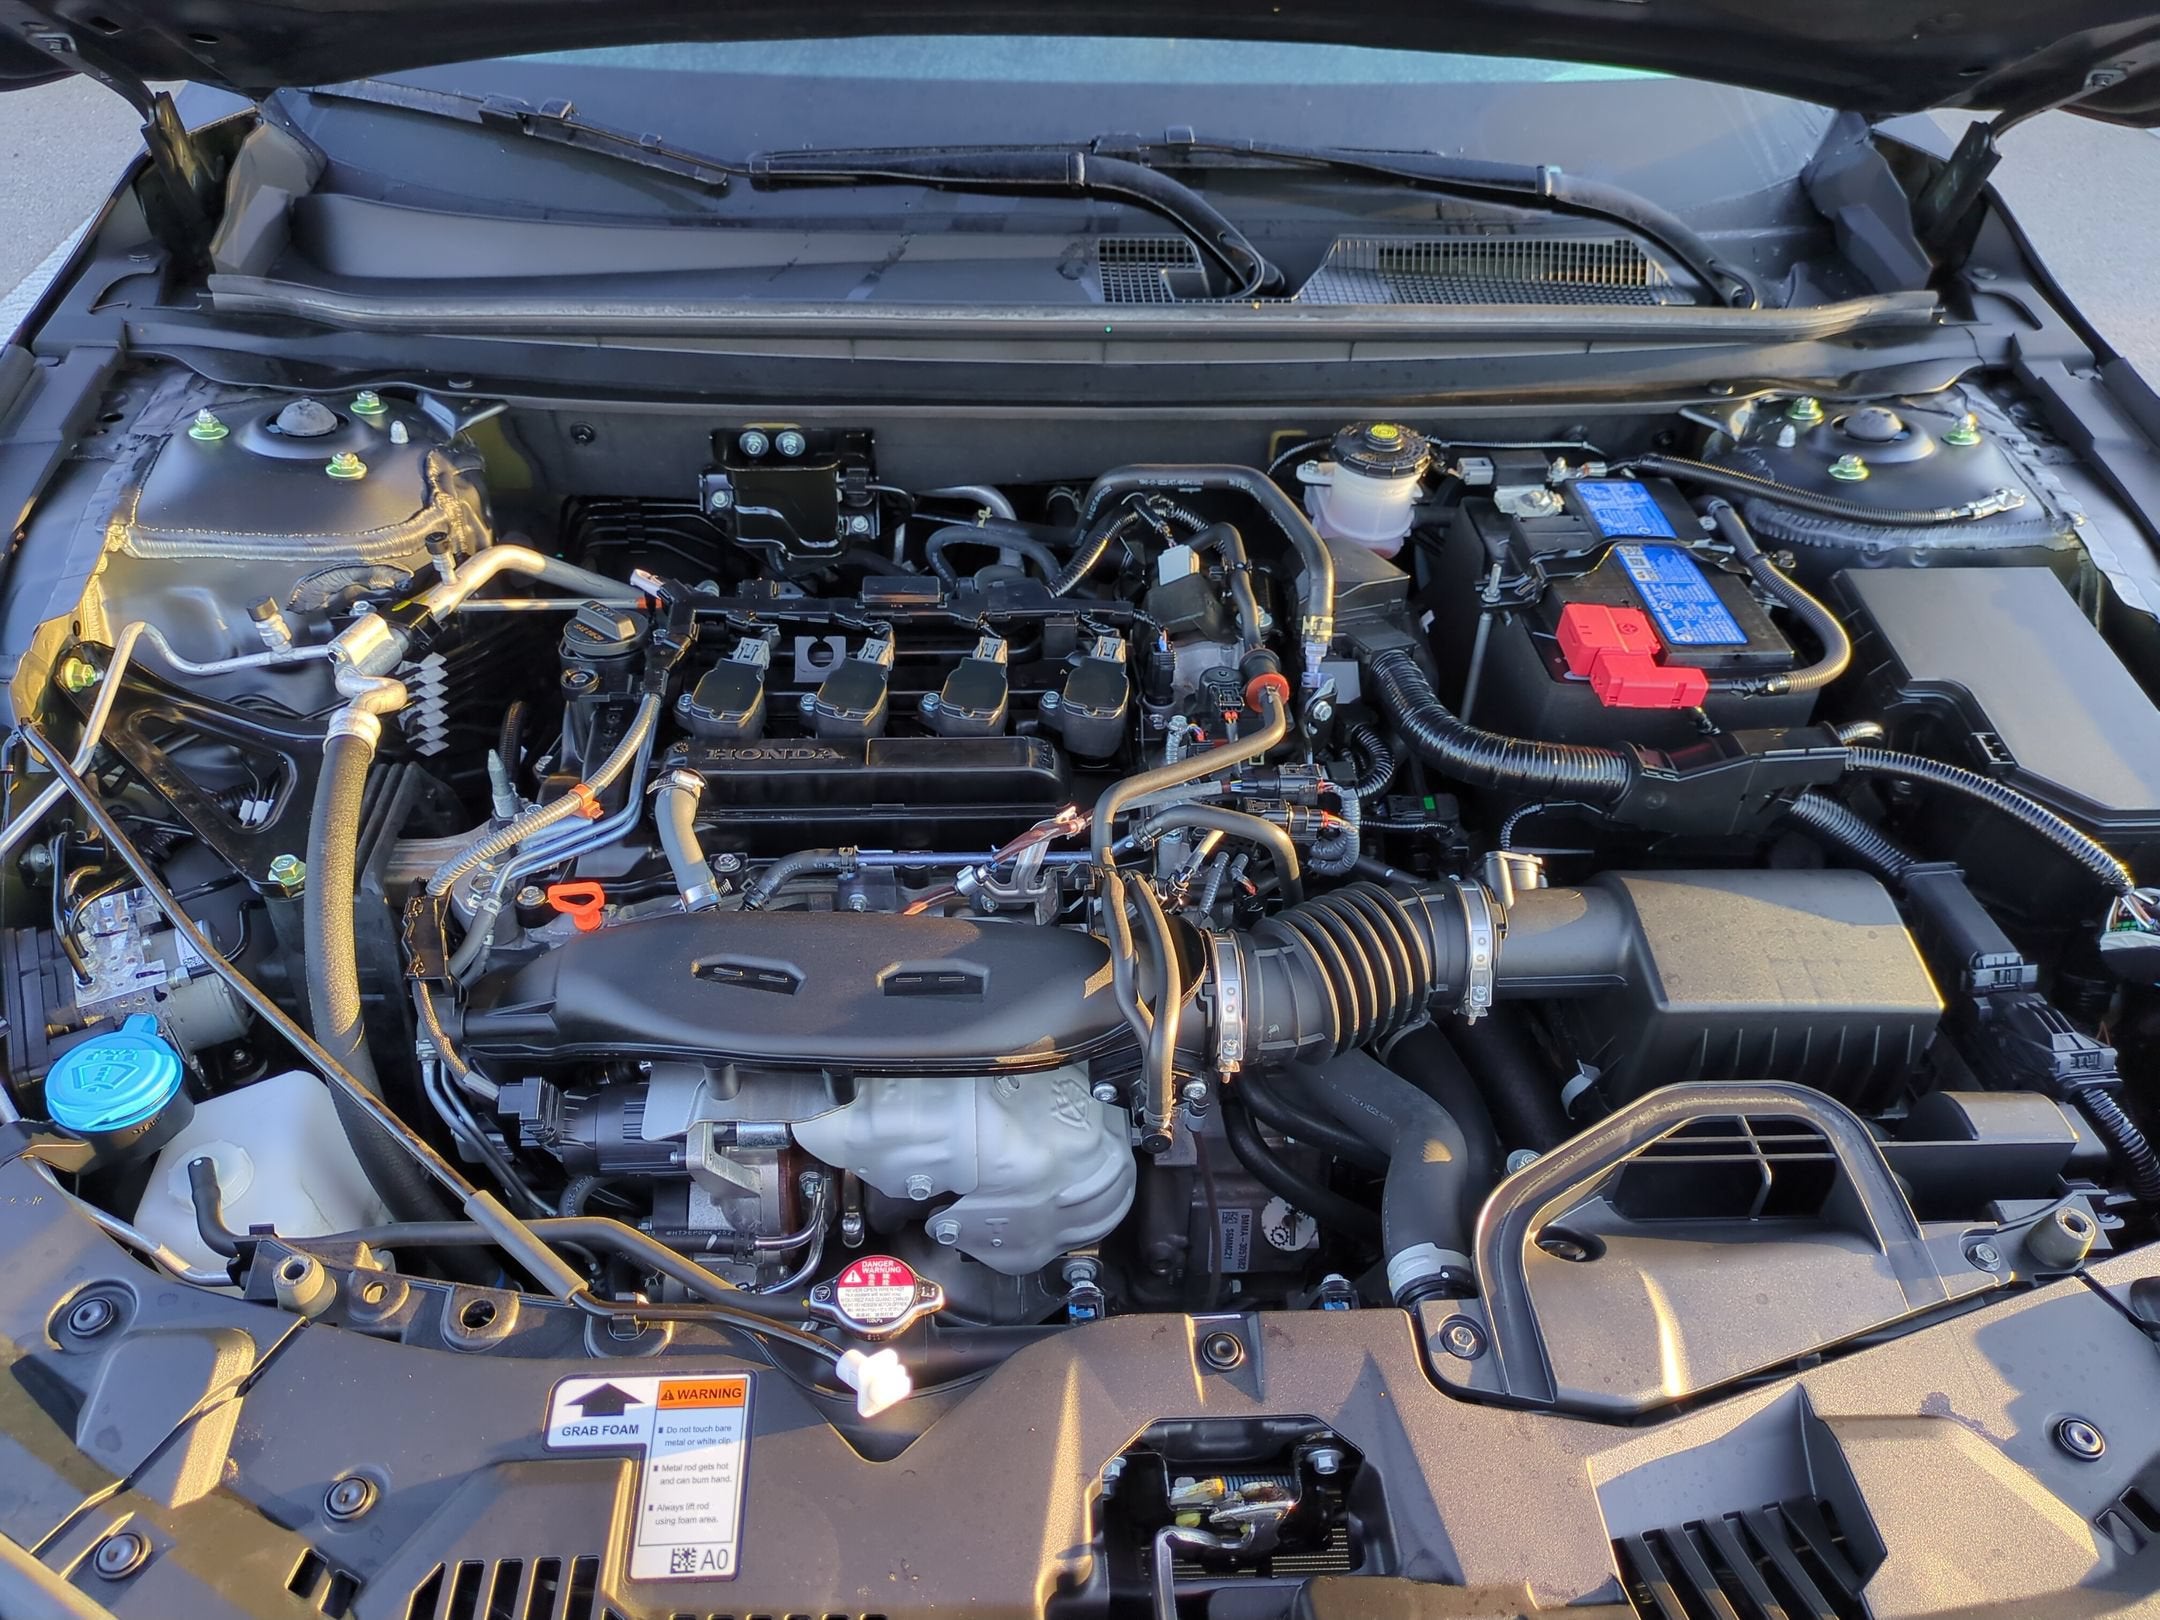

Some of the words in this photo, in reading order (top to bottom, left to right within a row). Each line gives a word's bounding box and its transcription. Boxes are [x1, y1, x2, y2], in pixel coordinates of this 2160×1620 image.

[705, 748, 846, 761] HONDA
[677, 1387, 742, 1400] WARNING
[561, 1425, 599, 1437] GRAB
[602, 1424, 640, 1436] FOAM
[718, 1437, 733, 1446] clip.
[661, 1464, 683, 1472] Metal
[684, 1463, 697, 1471] rod
[698, 1463, 715, 1473] gets
[716, 1462, 729, 1470] hot
[660, 1477, 675, 1485] and
[692, 1476, 710, 1484] burn
[711, 1475, 733, 1483] hand.
[657, 1503, 684, 1513] Always
[685, 1503, 695, 1511] lift
[696, 1502, 710, 1510] rod
[655, 1516, 676, 1526] using
[678, 1516, 698, 1524] foam
[700, 1548, 729, 1571] A0
